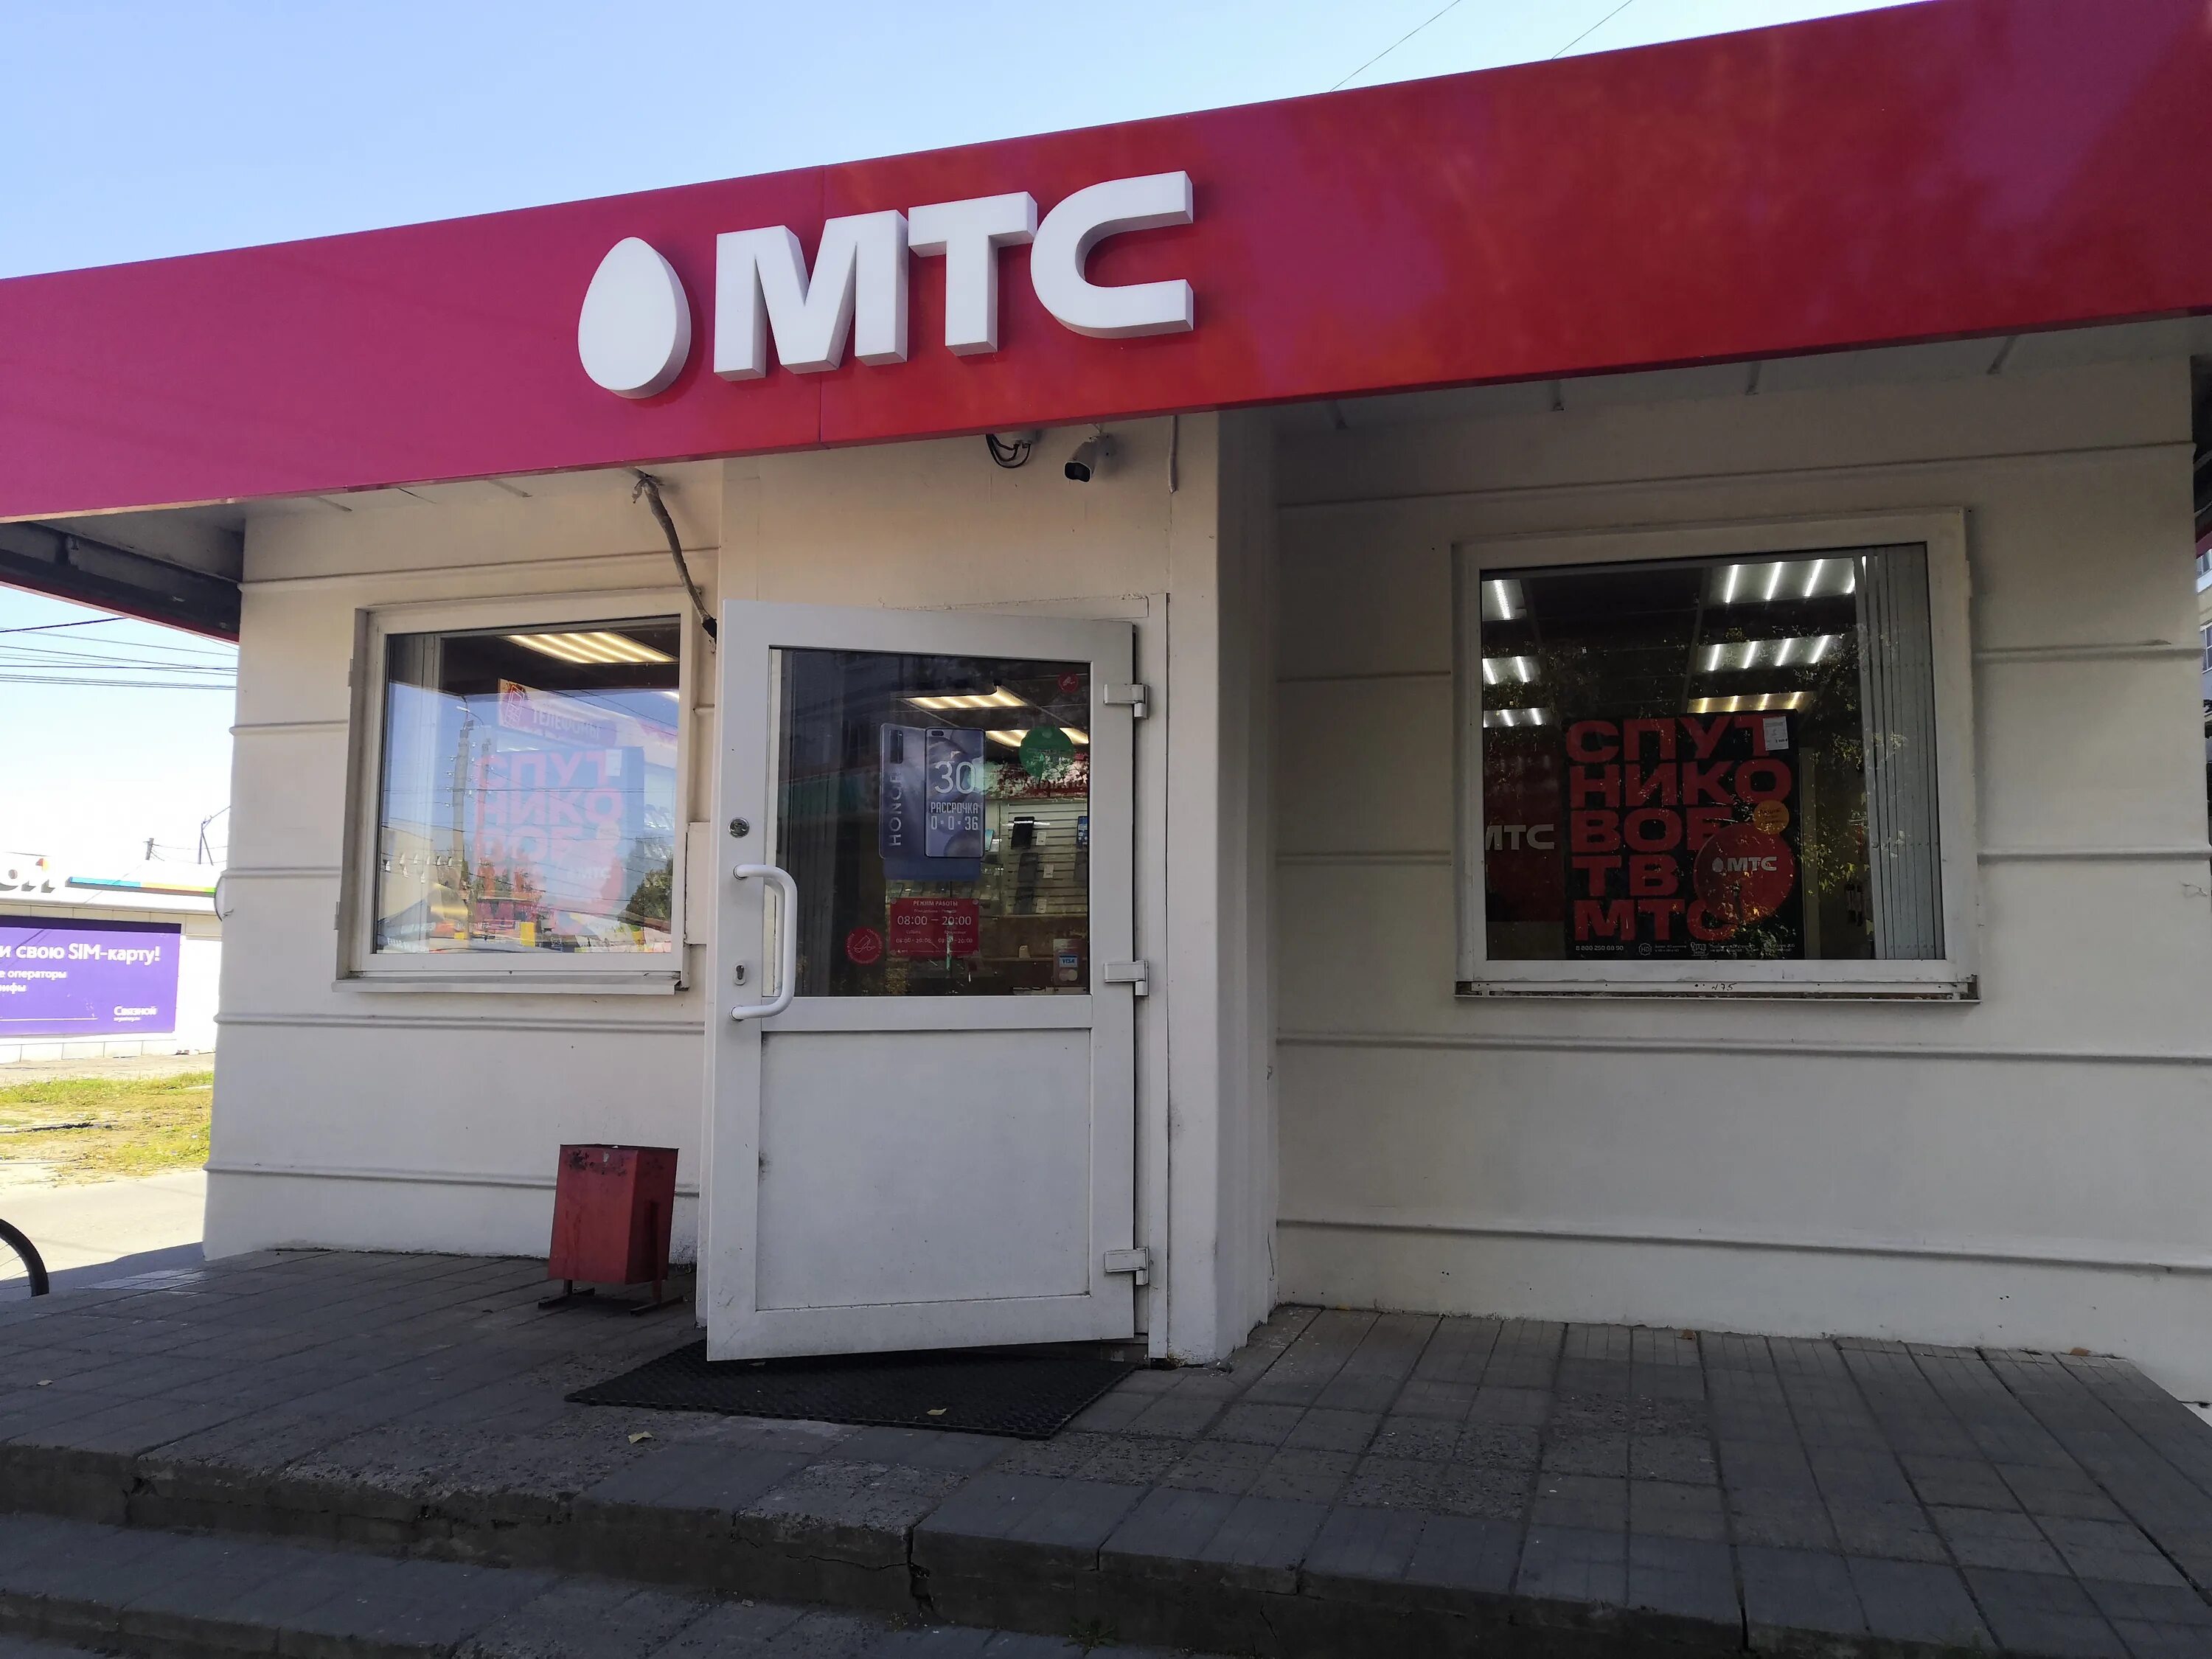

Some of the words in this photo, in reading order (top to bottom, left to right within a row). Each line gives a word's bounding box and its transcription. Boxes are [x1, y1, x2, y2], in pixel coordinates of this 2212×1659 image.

[713, 170, 1194, 382] МТС
[1565, 713, 1790, 762] СПУТ
[934, 761, 975, 794] 30
[1569, 758, 1792, 808] НИКО
[476, 787, 622, 826] НИКО
[888, 772, 902, 846] HONOR
[931, 801, 978, 813] РАССРОЧКА
[1571, 854, 1680, 897] ТВ
[1727, 856, 1777, 872] МТС
[897, 915, 928, 925] 08:00
[942, 915, 972, 925] 20:00
[15, 945, 65, 959] свою
[68, 943, 161, 966] SIM-карту!
[0, 982, 27, 995] ифы
[7, 970, 67, 981] операторы
